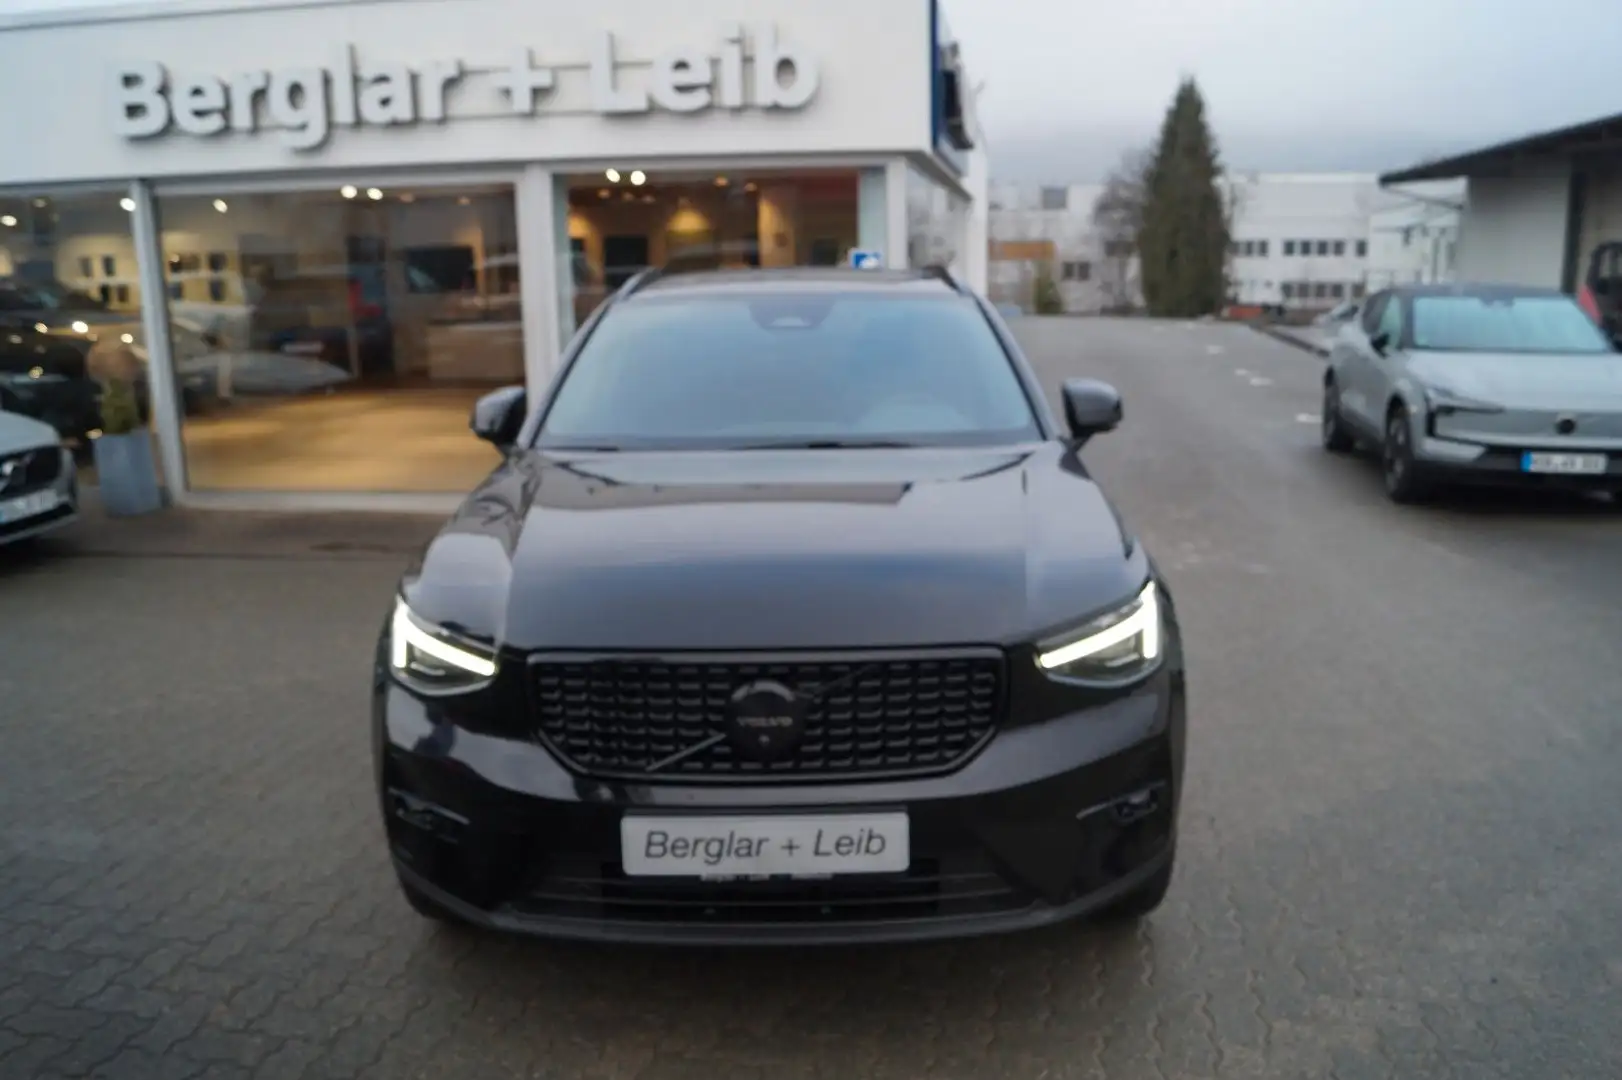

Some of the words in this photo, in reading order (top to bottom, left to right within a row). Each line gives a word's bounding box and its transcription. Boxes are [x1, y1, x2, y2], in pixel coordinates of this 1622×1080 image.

[114, 42, 463, 154] Berglar
[493, 46, 555, 115] +
[590, 22, 821, 115] Leib
[644, 830, 769, 866] Berglar
[781, 837, 800, 857] +
[813, 828, 887, 857] Leib
